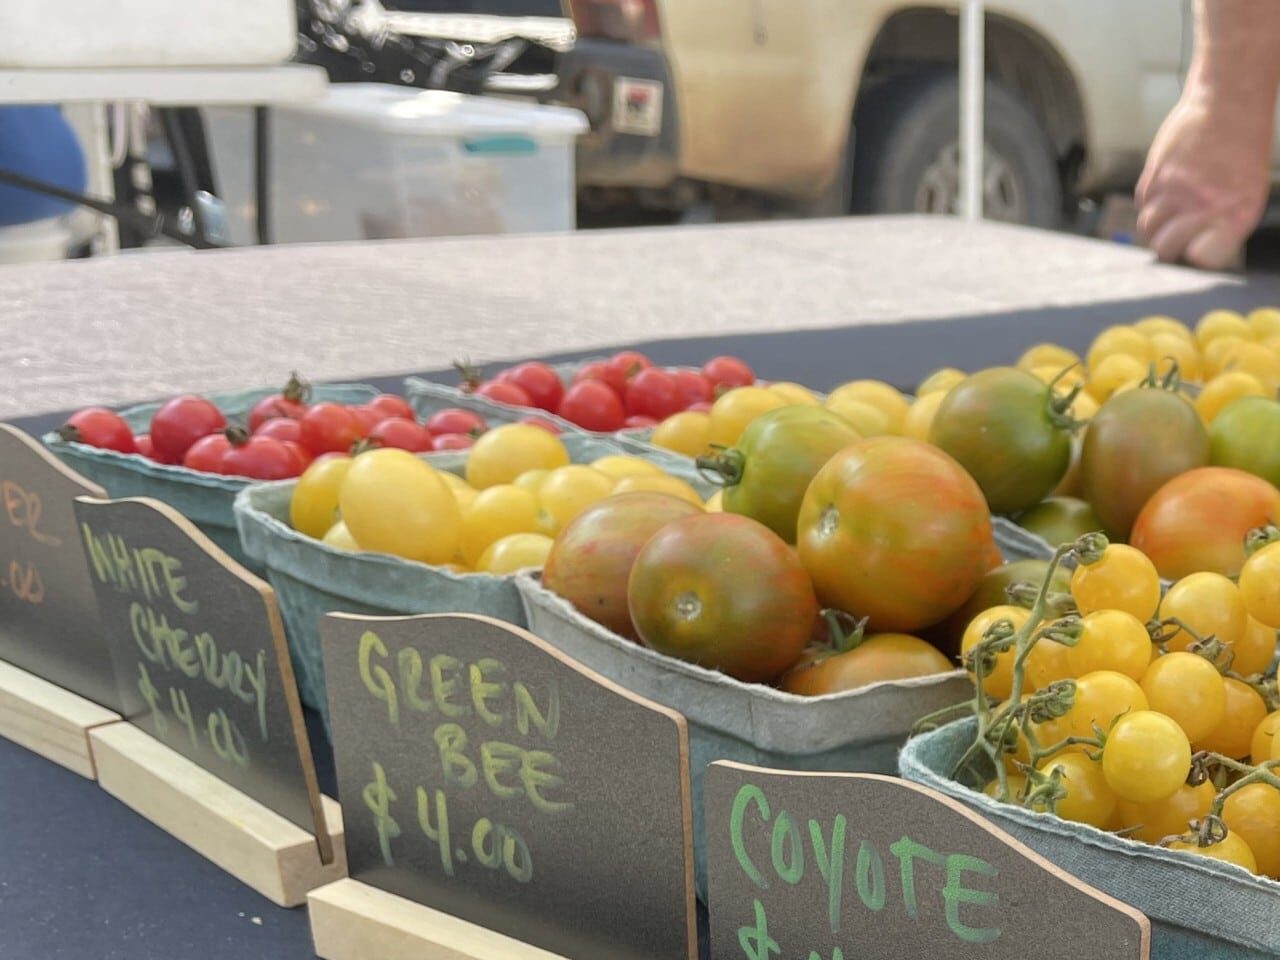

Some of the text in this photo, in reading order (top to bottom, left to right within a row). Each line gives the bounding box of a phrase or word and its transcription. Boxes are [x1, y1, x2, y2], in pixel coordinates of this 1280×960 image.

[82, 521, 198, 615] WHITE
[130, 601, 268, 743] CHERRY
[358, 629, 560, 738] GREEN
[433, 722, 576, 824] BEE
[730, 783, 1002, 942] COYOTE
